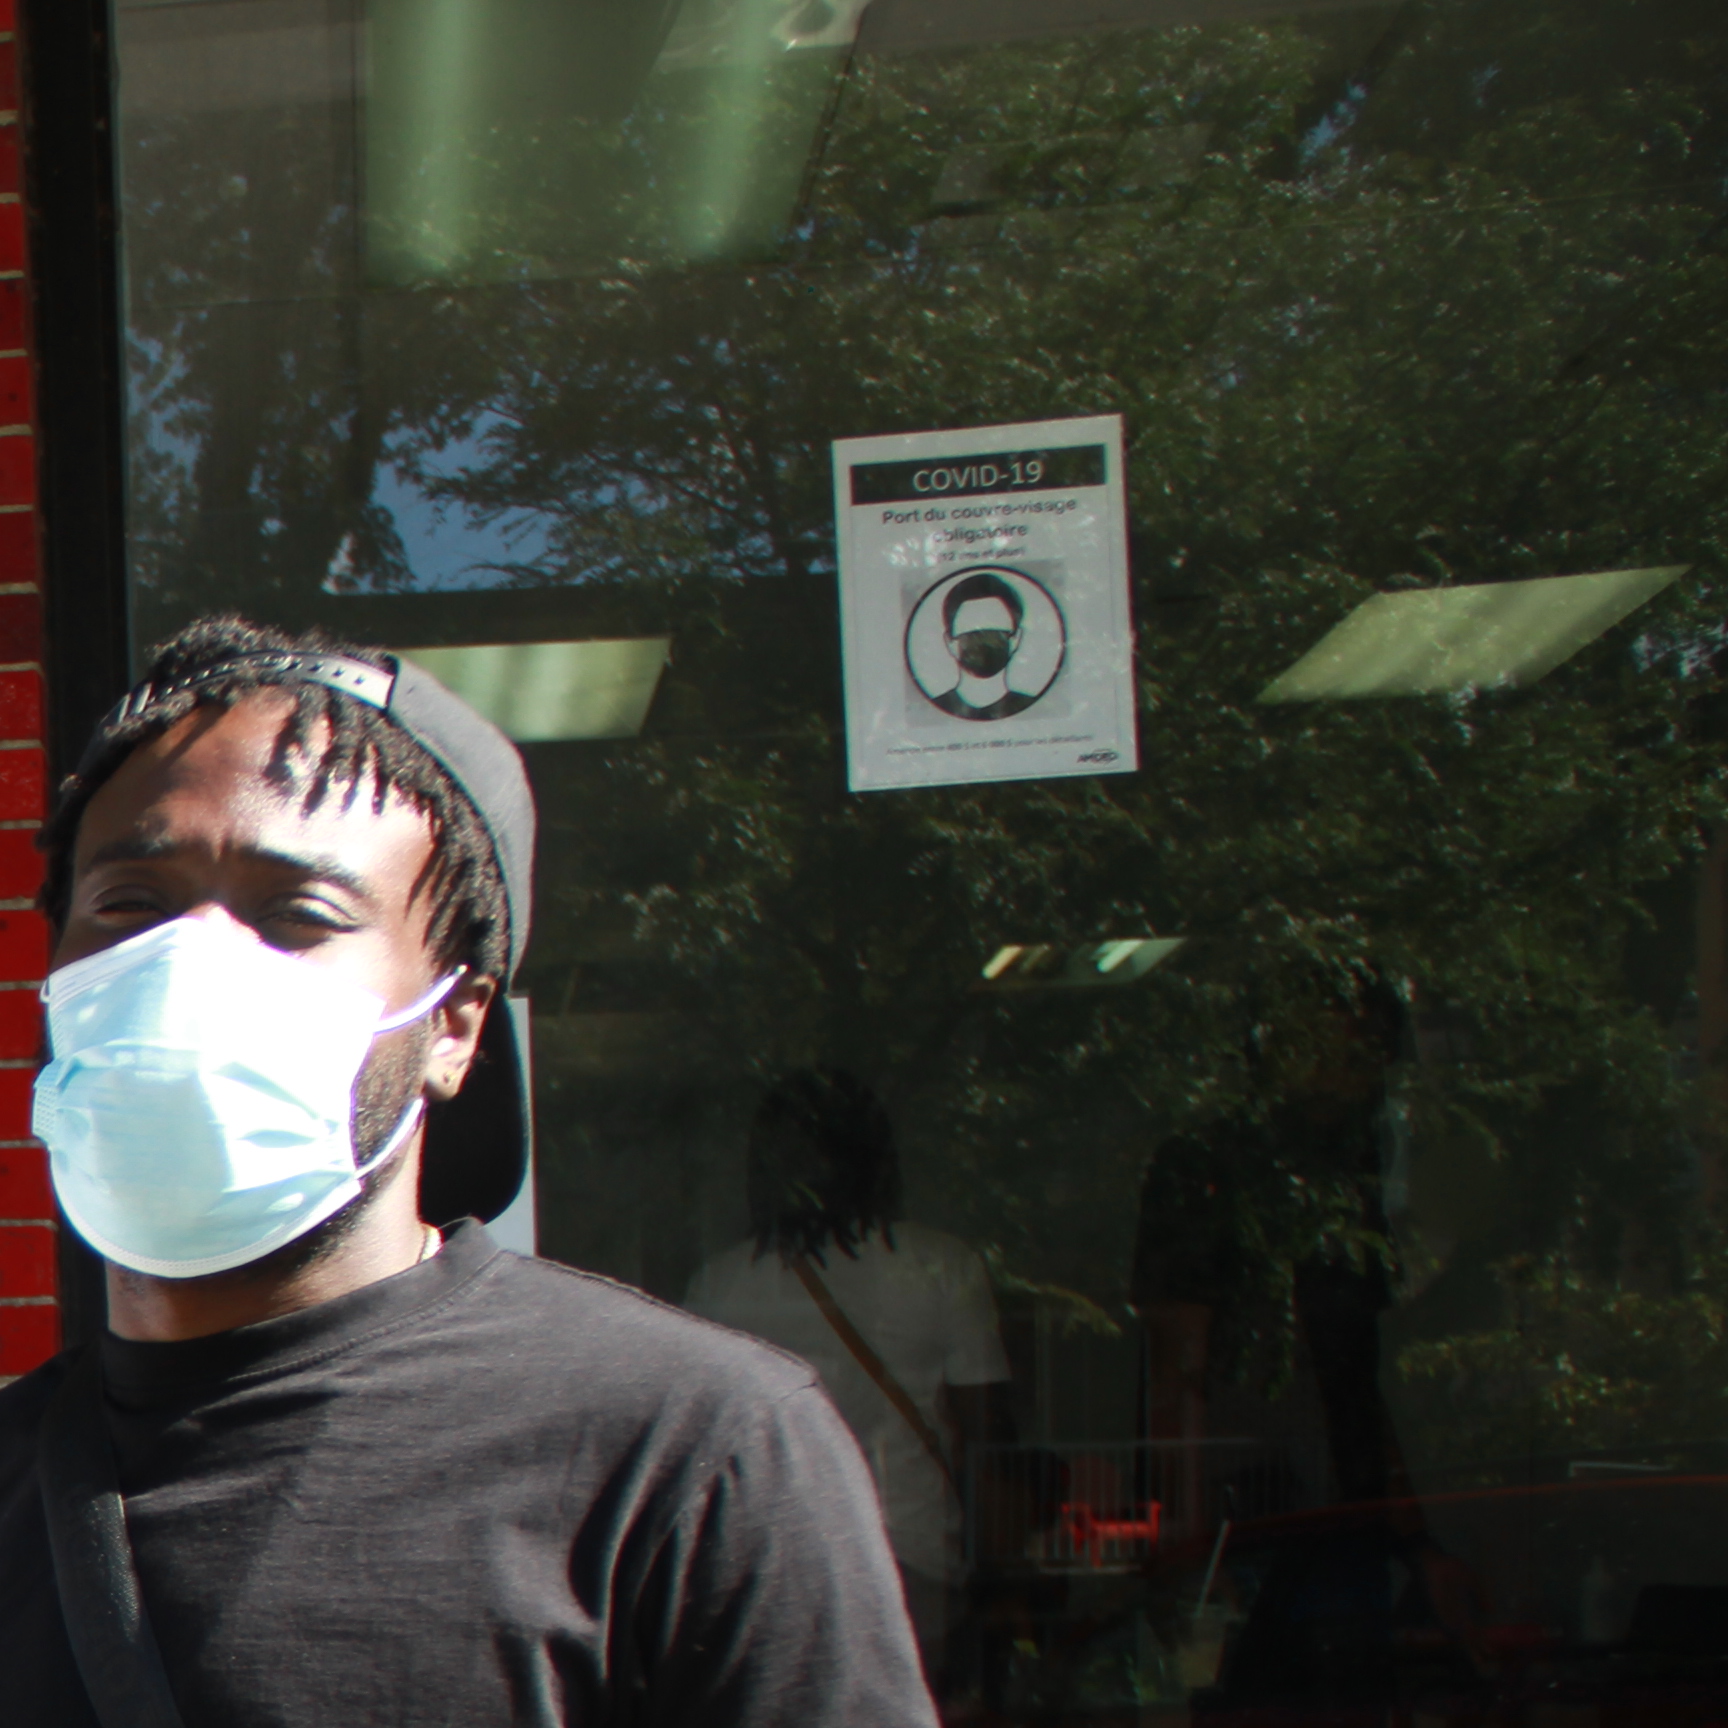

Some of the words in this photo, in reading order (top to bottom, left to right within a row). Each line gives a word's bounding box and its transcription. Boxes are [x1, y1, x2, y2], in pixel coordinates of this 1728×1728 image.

[912, 460, 1044, 493] COVID-19
[882, 508, 920, 525] Port
[924, 505, 946, 522] du
[951, 498, 1077, 521] couvre-visage
[933, 522, 1028, 545] obligatoire
